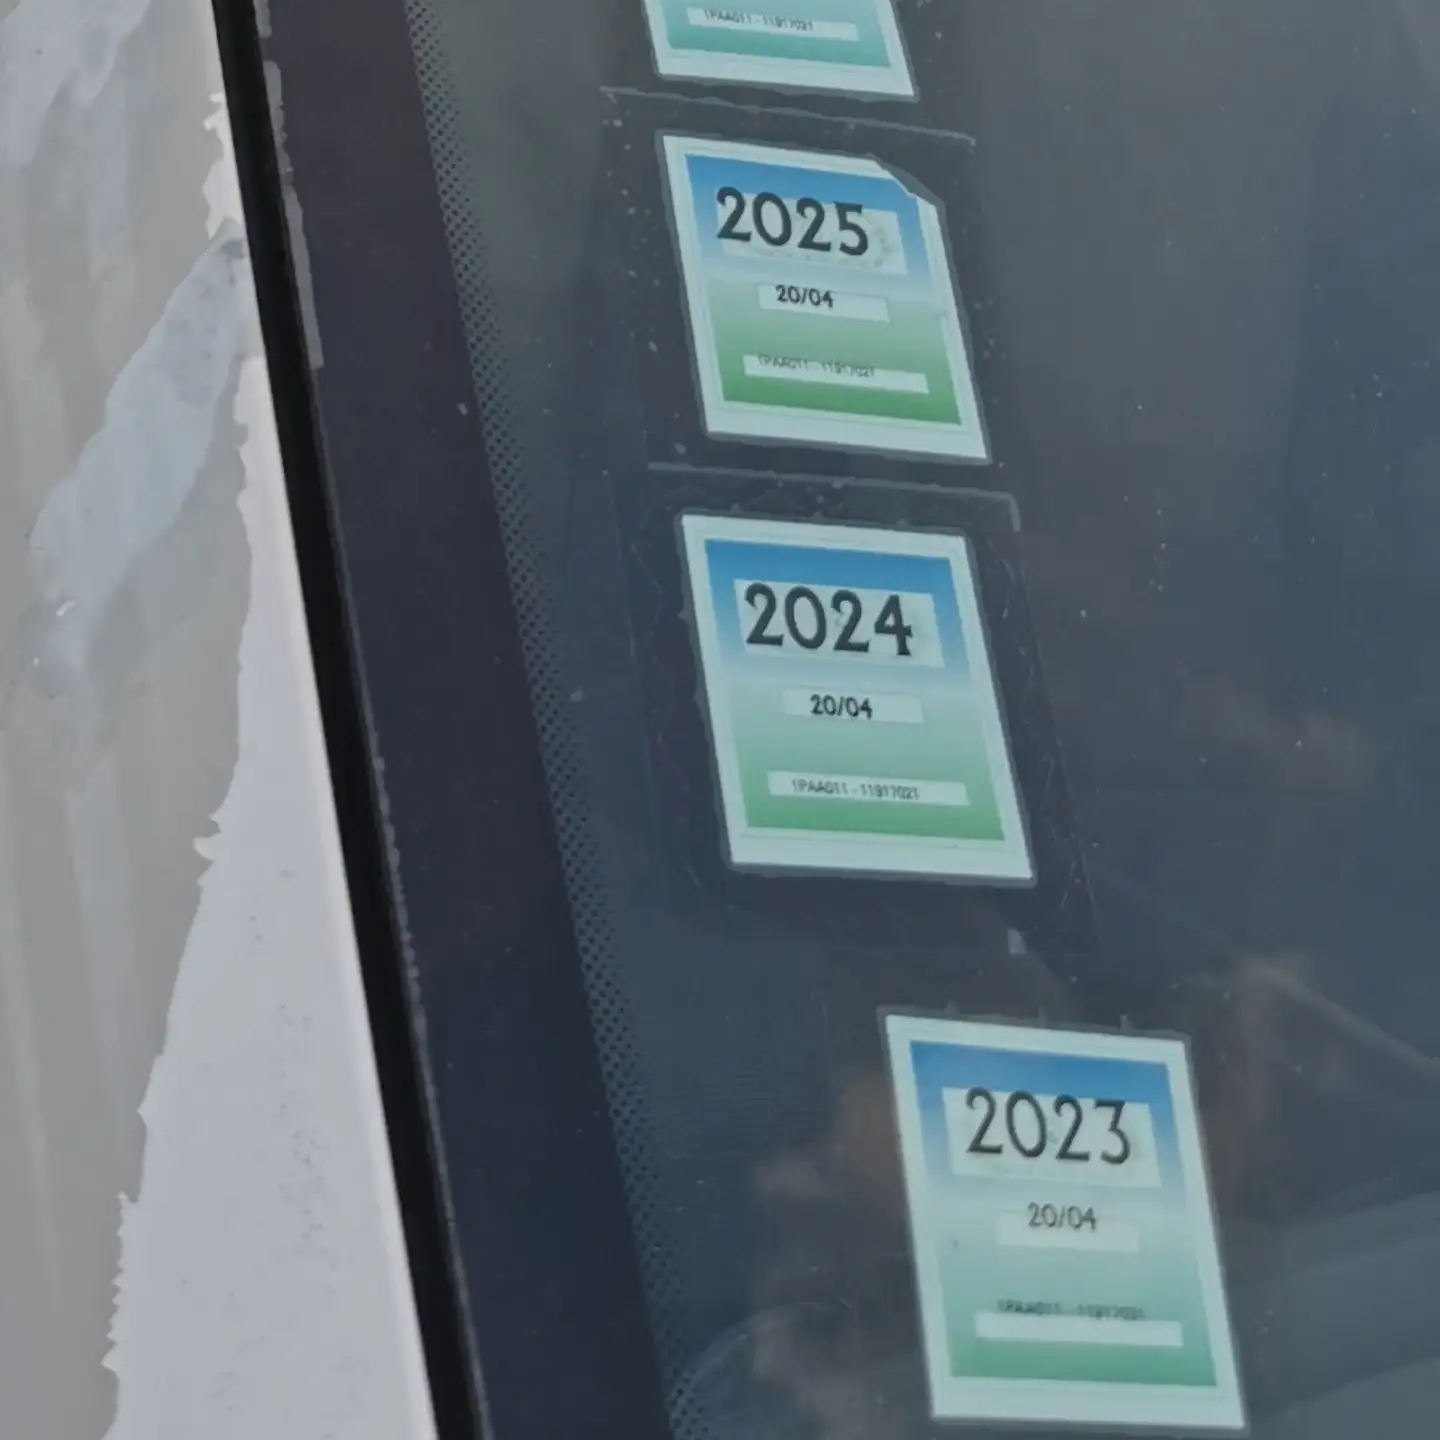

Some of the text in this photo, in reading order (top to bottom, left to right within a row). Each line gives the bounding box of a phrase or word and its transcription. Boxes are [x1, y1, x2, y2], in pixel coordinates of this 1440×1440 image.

[717, 186, 869, 256] 2025
[776, 284, 833, 308] 20/04
[745, 582, 913, 656] 2024
[810, 693, 873, 719] 20/04
[966, 1086, 1131, 1165] 2023
[1027, 1201, 1098, 1232] 20/04
